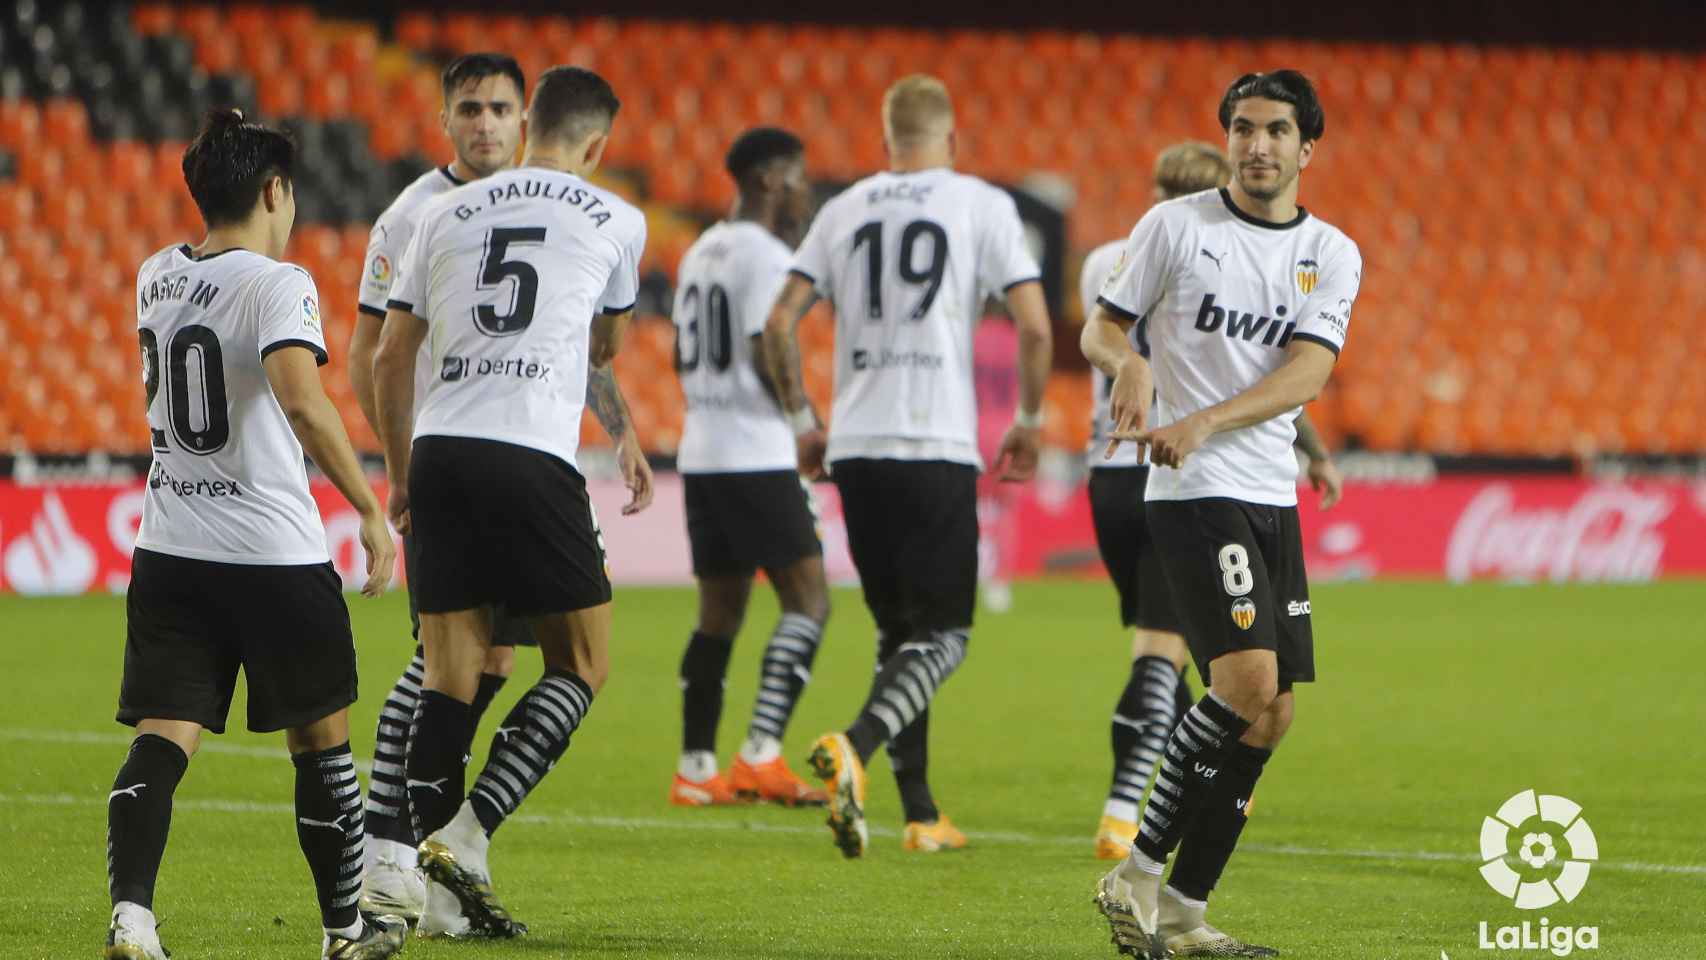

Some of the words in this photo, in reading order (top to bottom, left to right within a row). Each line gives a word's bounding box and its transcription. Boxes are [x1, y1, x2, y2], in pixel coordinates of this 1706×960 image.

[455, 204, 482, 221] G.
[489, 180, 612, 229] PAULISTA
[140, 275, 188, 312] KANG
[189, 279, 219, 311] IN
[472, 226, 547, 338] 5
[853, 220, 948, 321] 19
[674, 283, 732, 374] 30
[1219, 544, 1253, 597] 8
